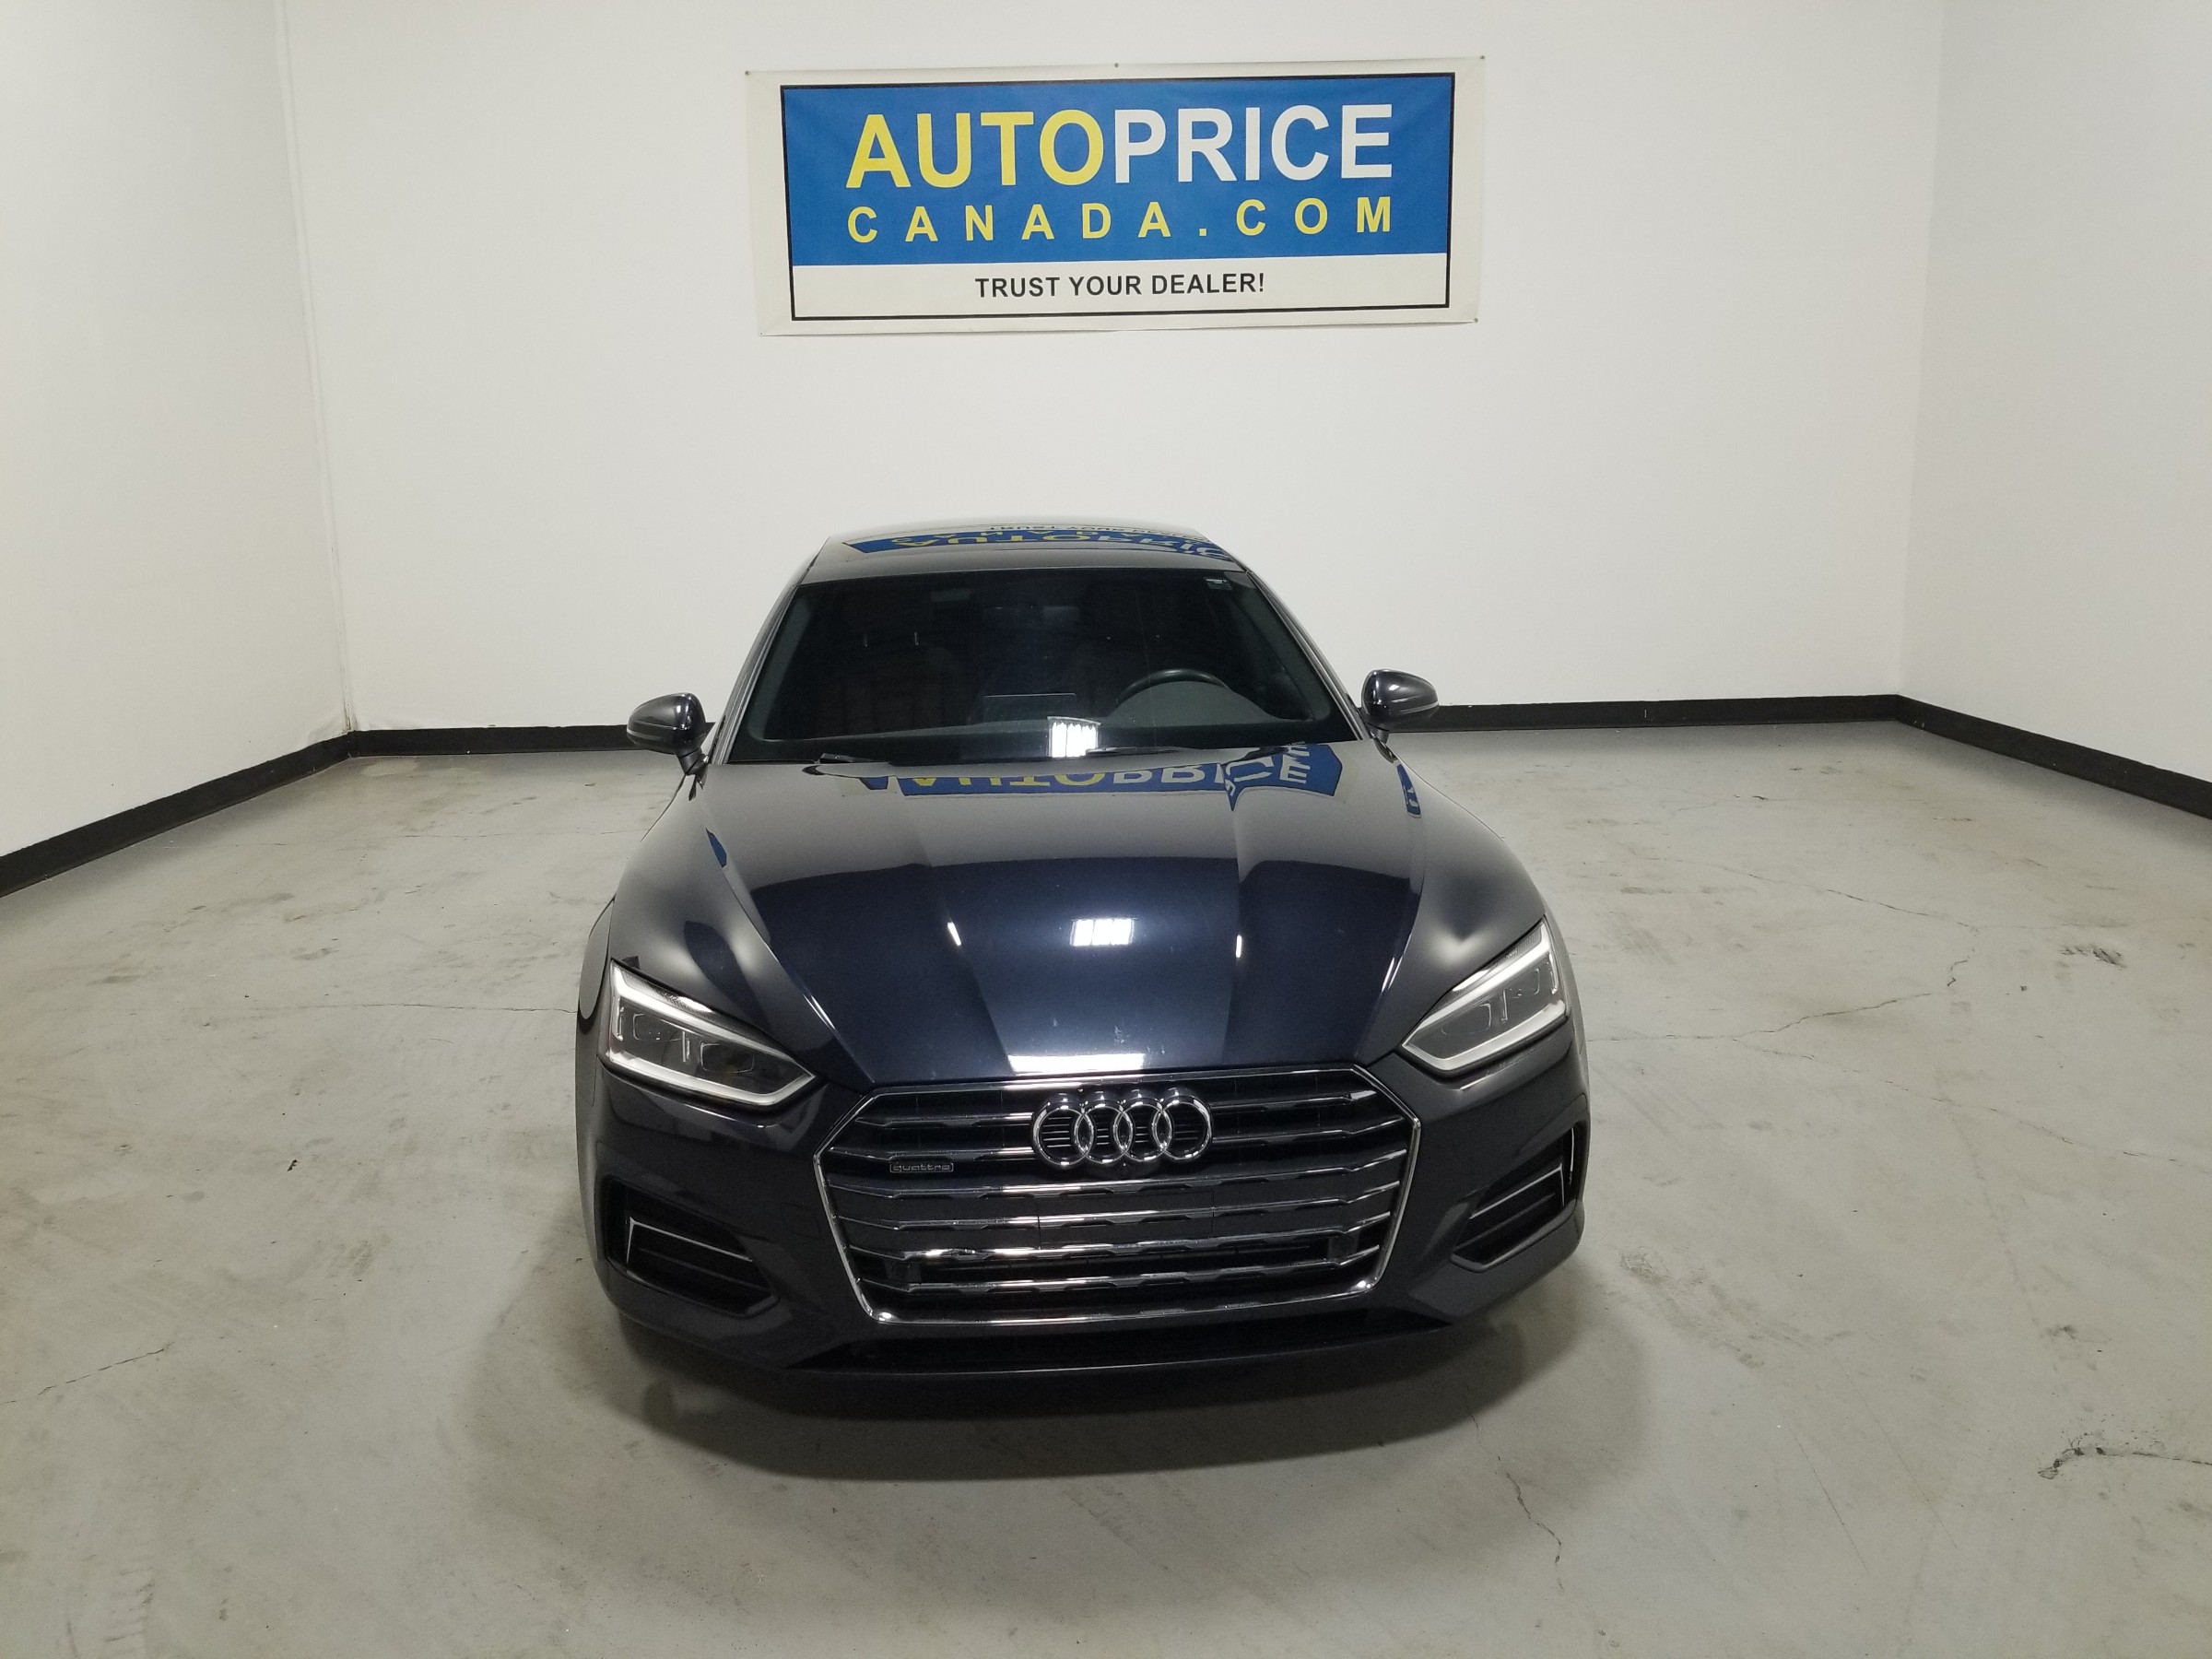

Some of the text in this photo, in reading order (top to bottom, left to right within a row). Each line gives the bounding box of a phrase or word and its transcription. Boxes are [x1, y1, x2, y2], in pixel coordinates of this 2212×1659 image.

[846, 103, 1393, 189] AUTOPRICE
[847, 195, 1391, 243] CANADA.COM
[974, 272, 1265, 298] TRUST YOUR DEALER!
[892, 1163, 951, 1173] quattro
